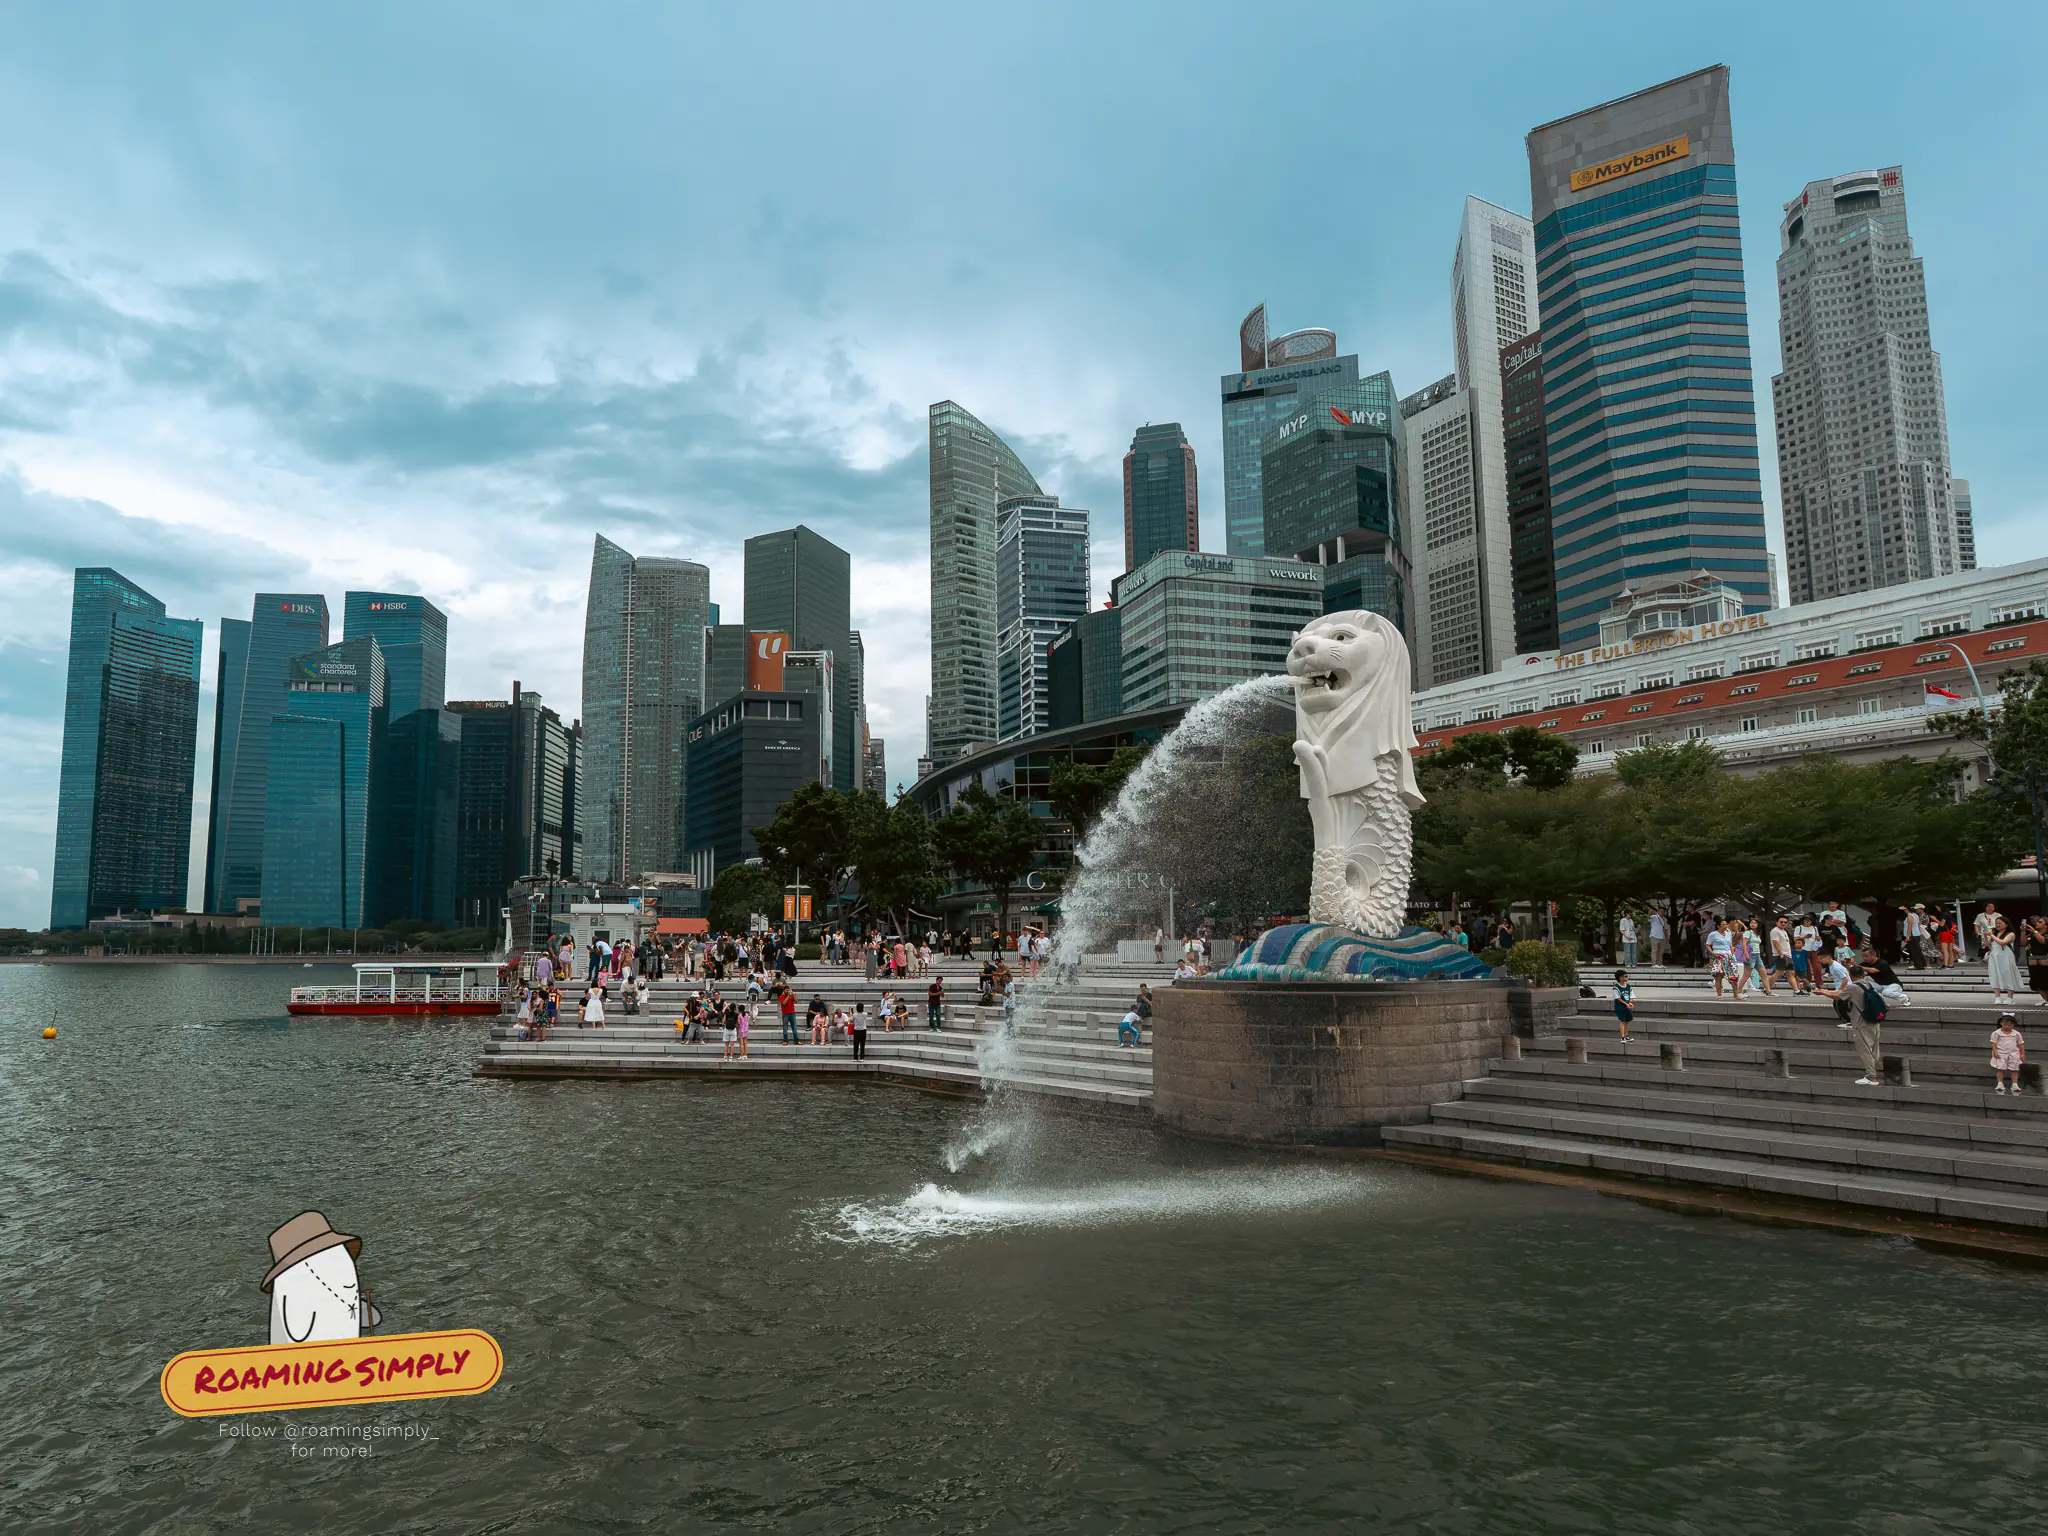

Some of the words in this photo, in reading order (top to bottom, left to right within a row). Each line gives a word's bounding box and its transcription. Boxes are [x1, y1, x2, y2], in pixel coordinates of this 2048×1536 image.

[1595, 144, 1677, 180] Maybank
[1880, 186, 1904, 197] UOB
[1257, 364, 1342, 385] SINGAPORELAND
[1352, 410, 1387, 425] MYP
[1280, 414, 1308, 440] MYP
[1184, 555, 1234, 572] CapitaLand
[1269, 568, 1318, 581] wework
[1121, 575, 1147, 597] wework
[291, 603, 316, 614] DBS
[383, 602, 407, 610] HSBC
[1554, 654, 1586, 670] THE
[1592, 629, 1693, 662] FULLERTON
[1702, 613, 1769, 639] HOTEL
[320, 662, 355, 670] standard
[320, 668, 357, 676] chartered
